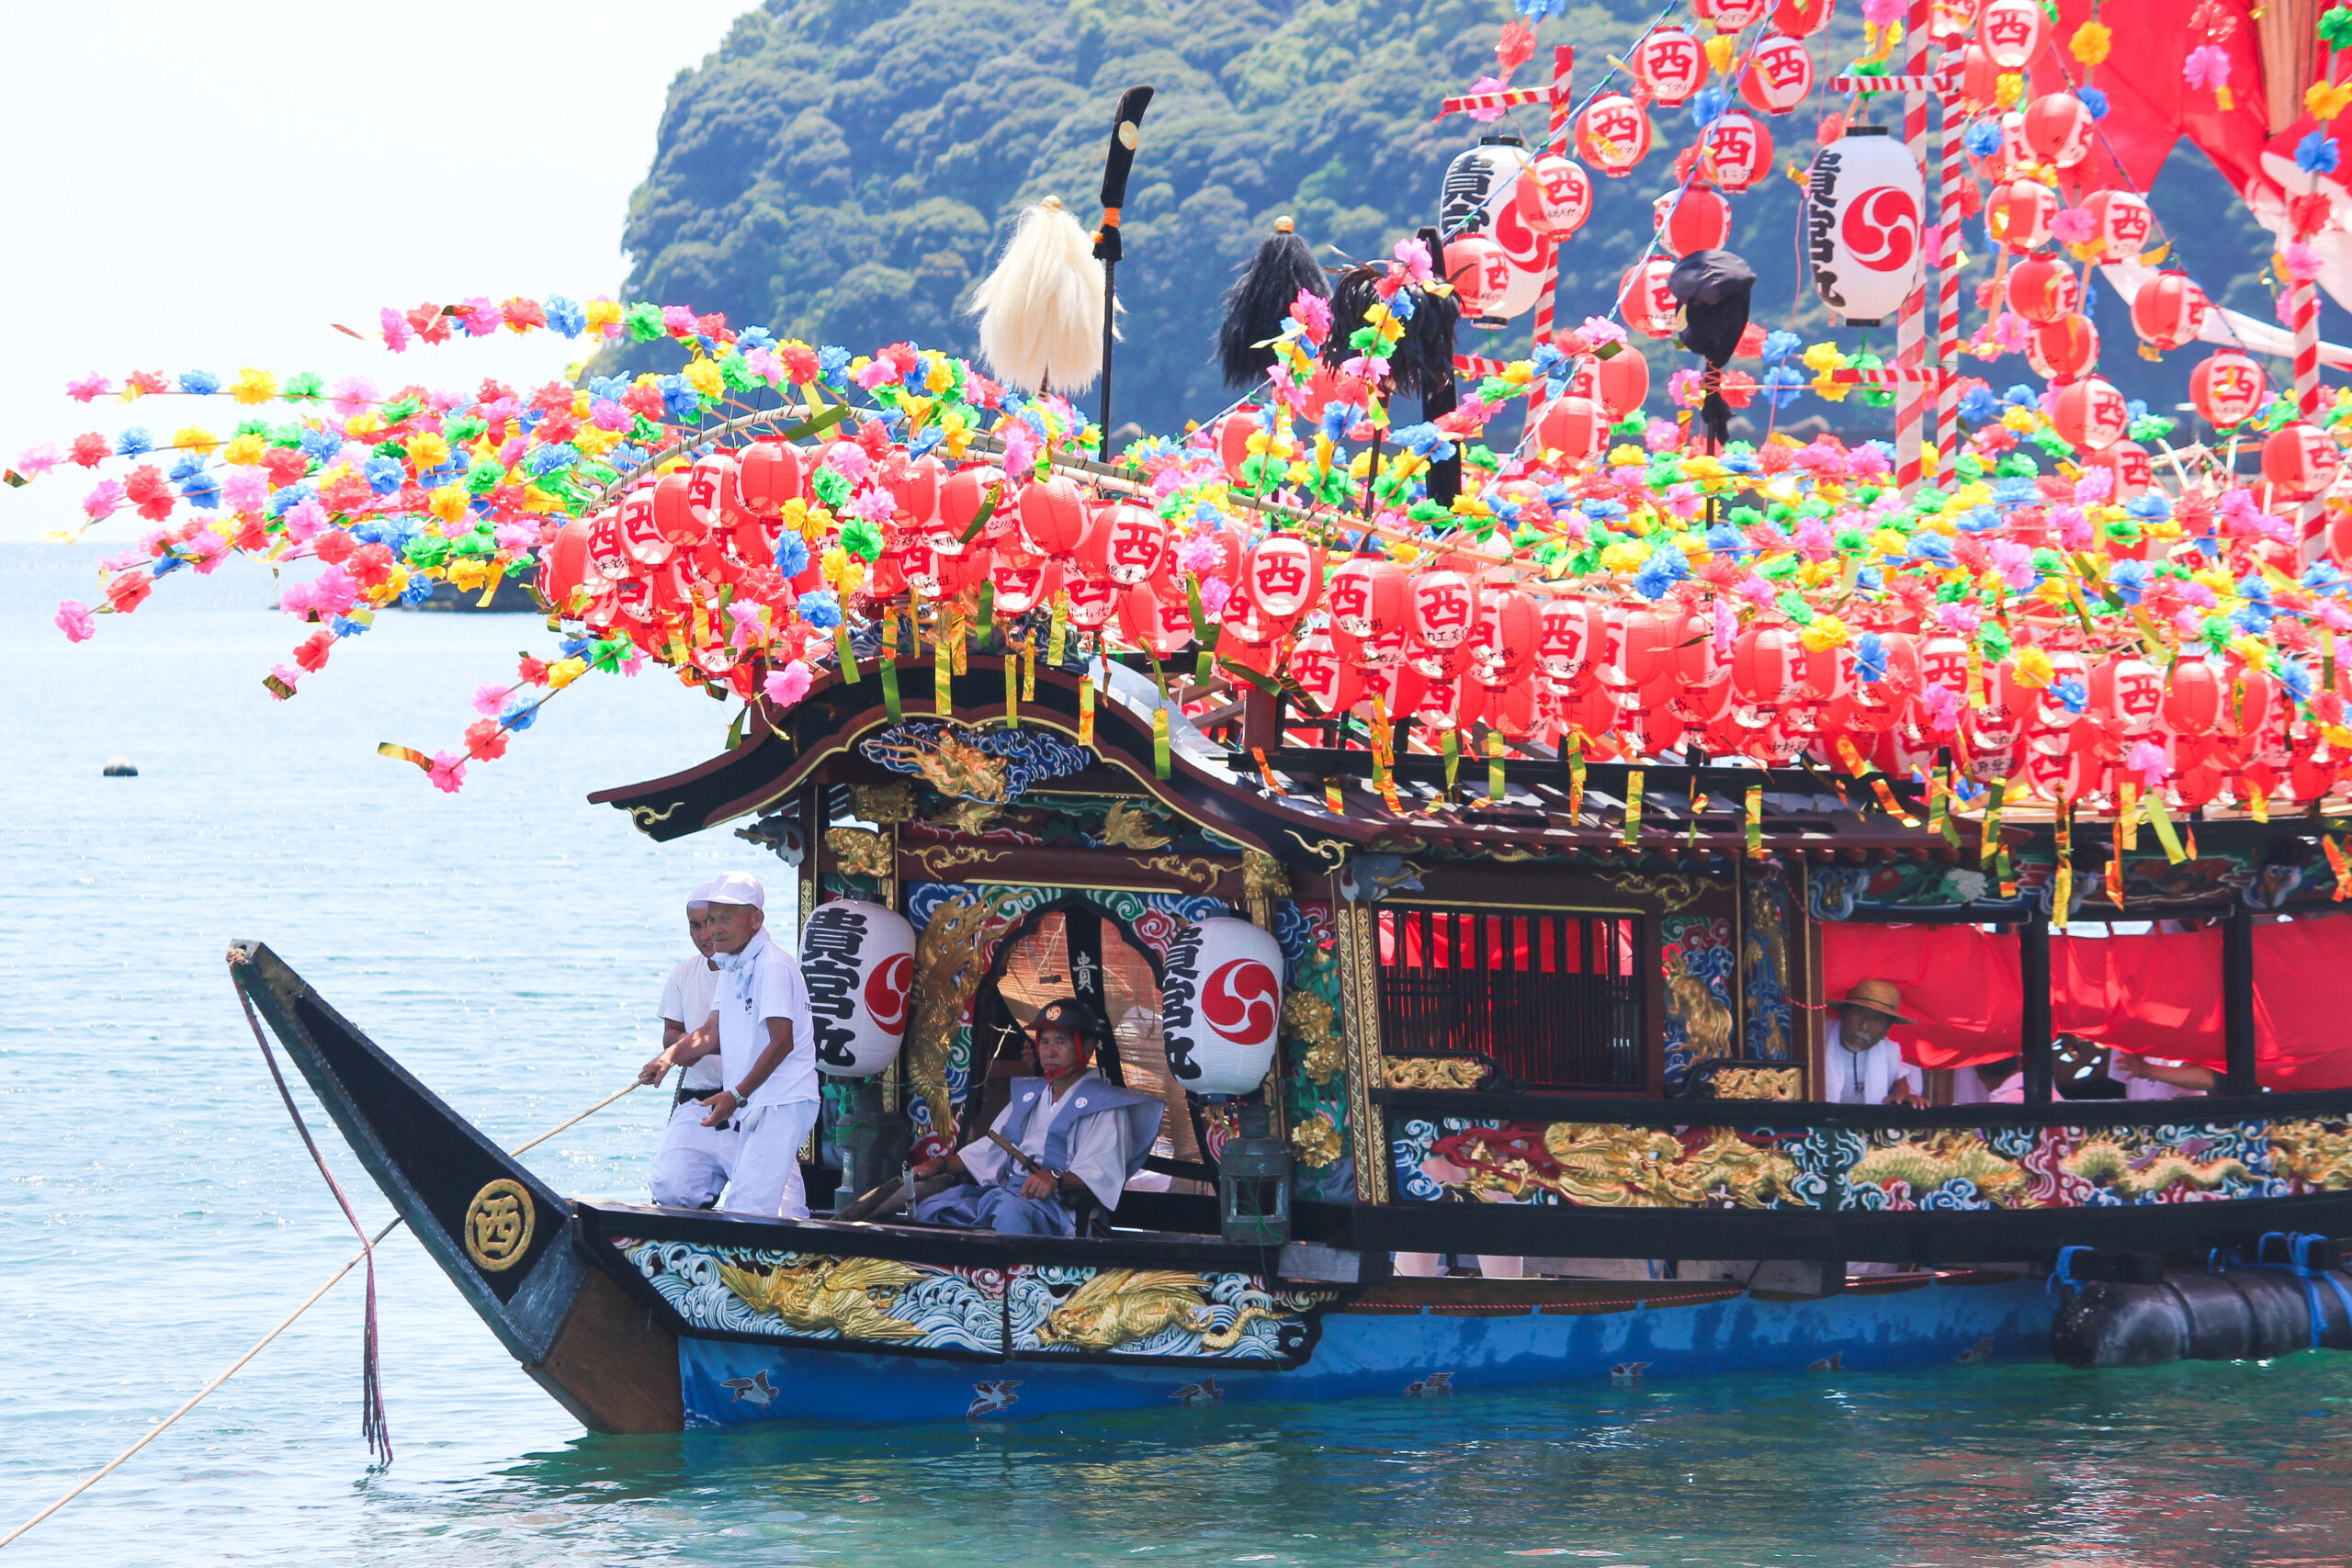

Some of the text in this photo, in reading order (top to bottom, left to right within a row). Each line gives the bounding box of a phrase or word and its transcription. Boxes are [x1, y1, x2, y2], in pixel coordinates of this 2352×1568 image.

[1989, 9, 2033, 48] 西
[1647, 40, 1693, 82] 西
[1758, 45, 1806, 90] 西
[1591, 105, 1638, 144] 西
[1708, 126, 1752, 167] 西
[1540, 166, 1585, 206] 西
[2111, 204, 2147, 243] 西
[2213, 365, 2257, 405] 西
[2093, 390, 2125, 432] 西
[688, 466, 721, 510] 西
[2120, 451, 2150, 486] 西
[588, 516, 621, 561] 西
[1113, 523, 1163, 570] 西
[1256, 552, 1306, 597] 西
[1329, 573, 1370, 619] 西
[1418, 582, 1470, 629] 西
[1538, 614, 1584, 660] 西
[1291, 649, 1336, 696] 西
[1923, 652, 1968, 693] 西
[2120, 673, 2160, 716] 西
[801, 908, 867, 1067] 貴宮丸
[1072, 951, 1099, 995] 貴
